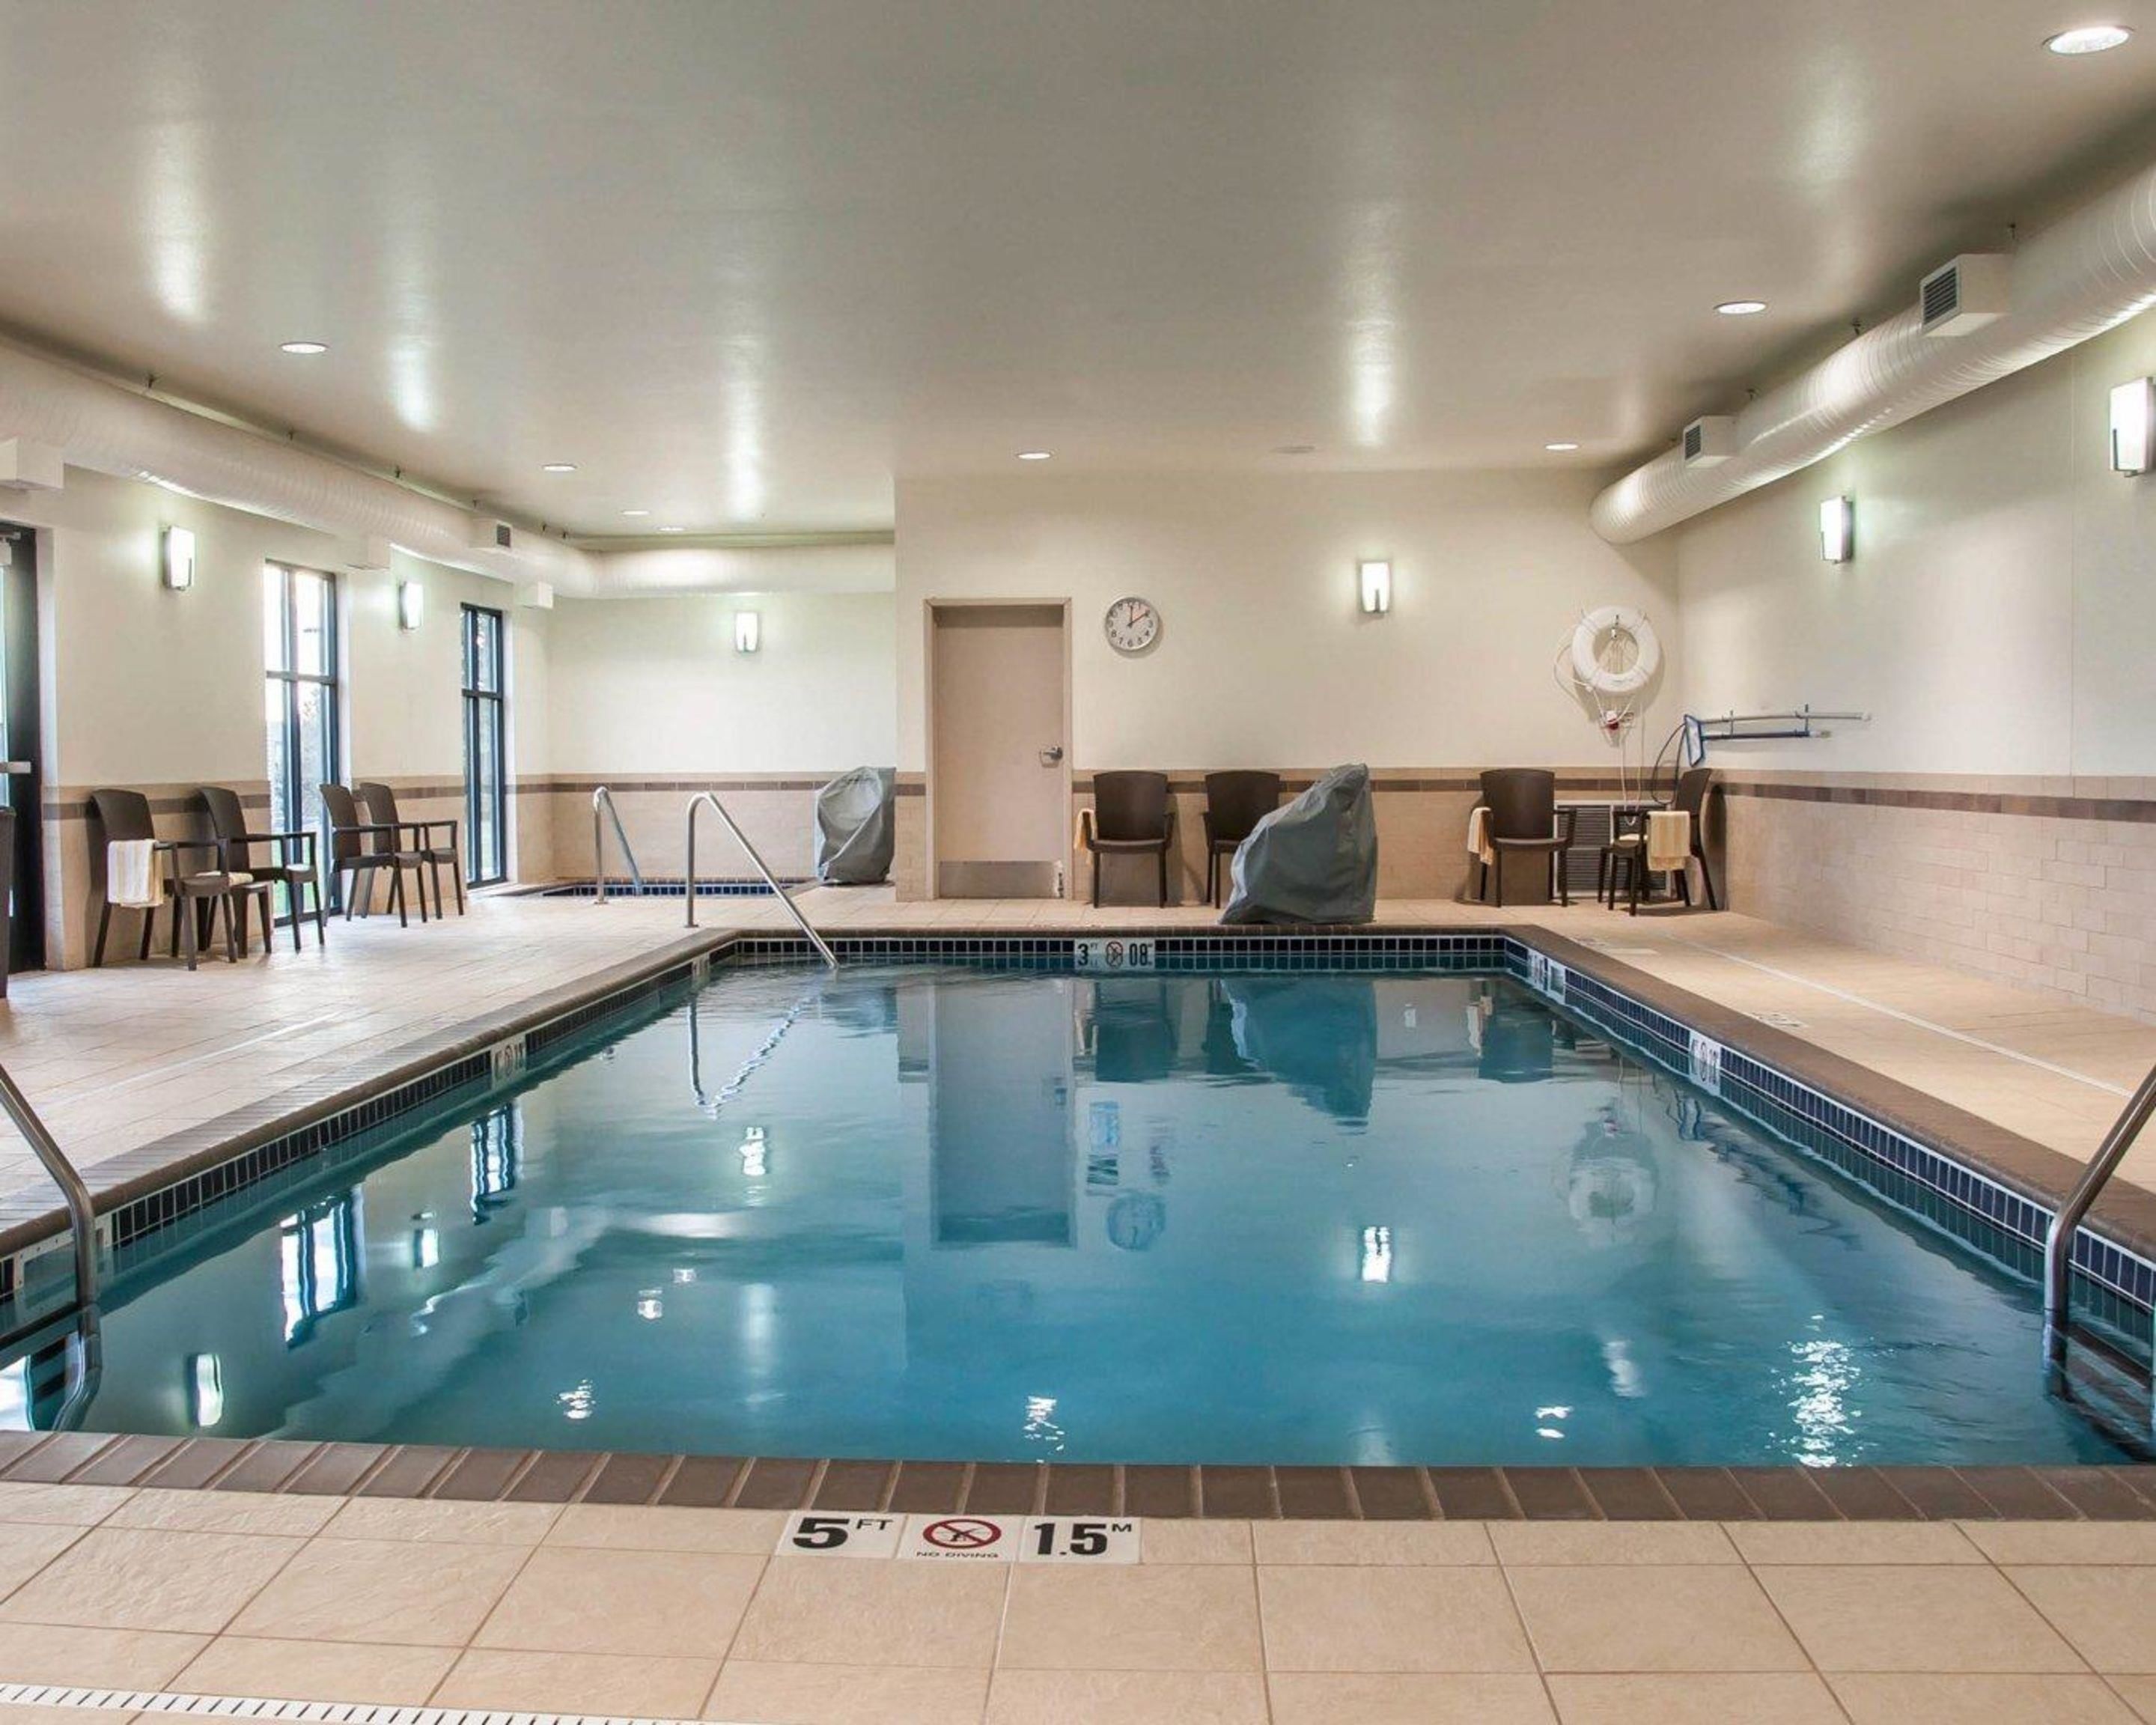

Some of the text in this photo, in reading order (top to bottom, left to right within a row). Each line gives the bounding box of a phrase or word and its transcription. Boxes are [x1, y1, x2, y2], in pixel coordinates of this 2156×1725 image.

[793, 1517, 894, 1549] 5 FT
[1034, 1523, 1132, 1555] 1.5 M
